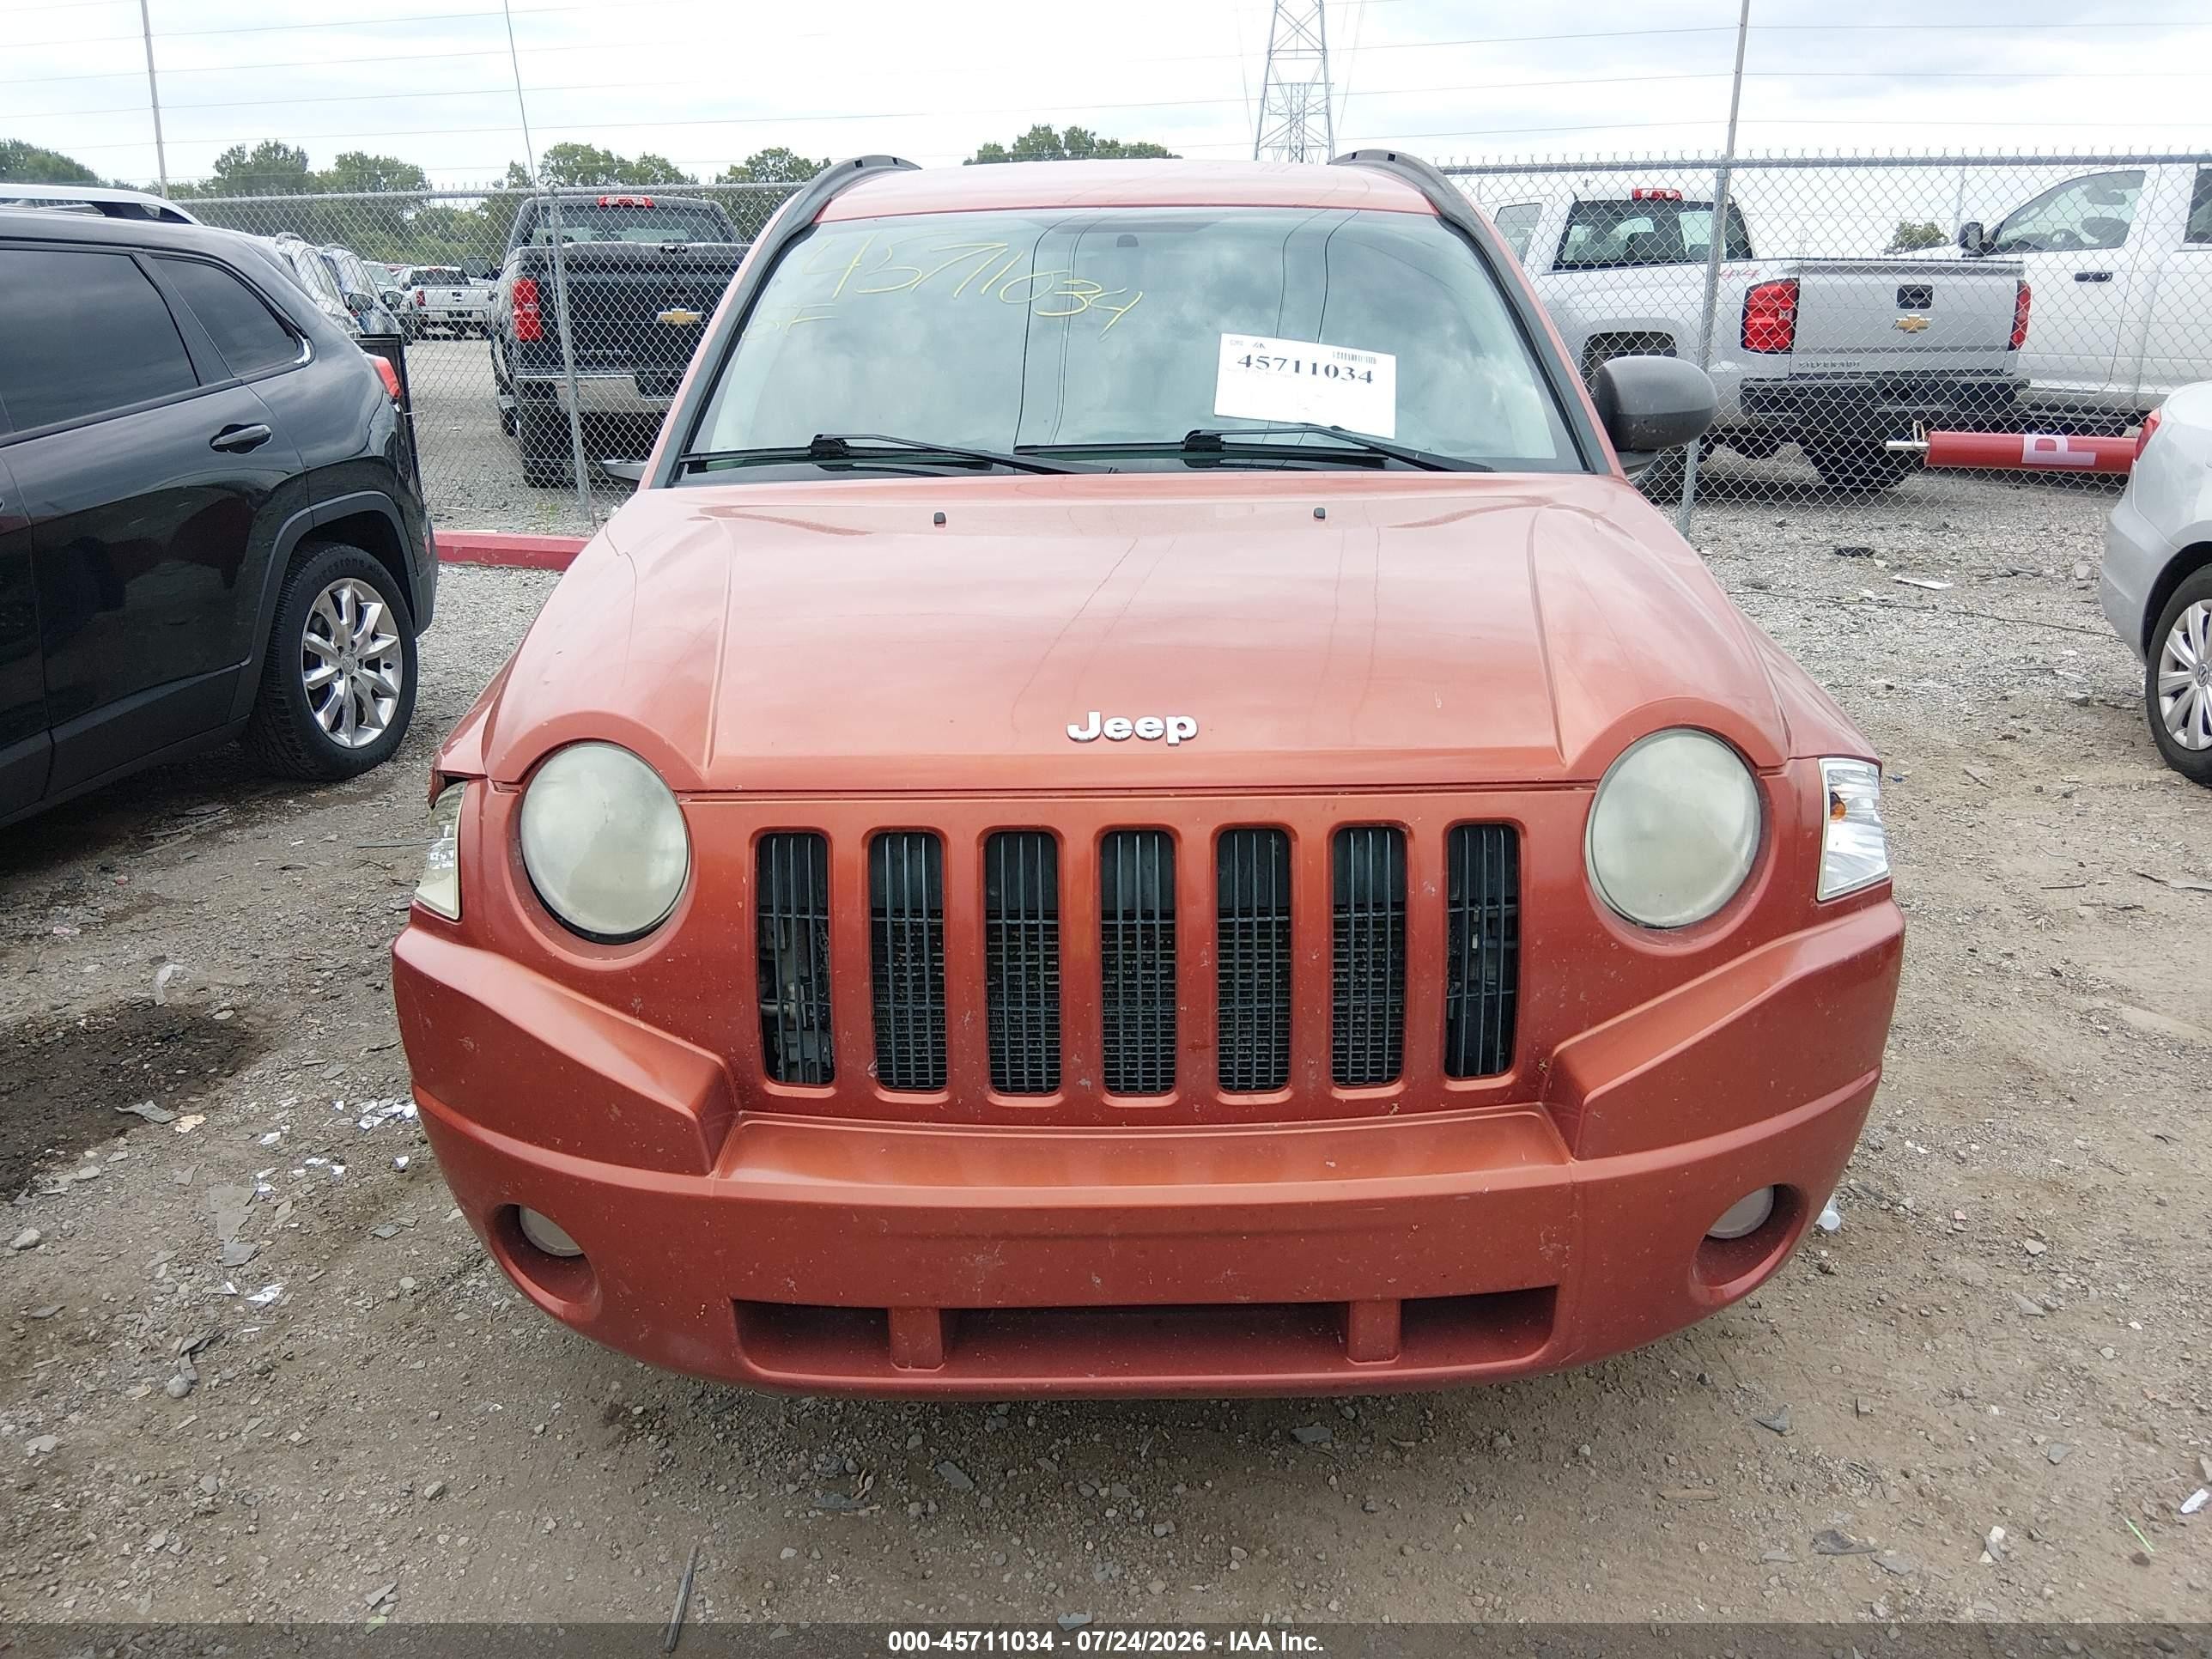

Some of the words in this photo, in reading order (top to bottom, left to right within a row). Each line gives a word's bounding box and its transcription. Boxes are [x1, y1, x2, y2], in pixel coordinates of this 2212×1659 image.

[1237, 354, 1374, 384] 45711034
[2021, 434, 2097, 466] P
[1066, 711, 1199, 746] Jeep
